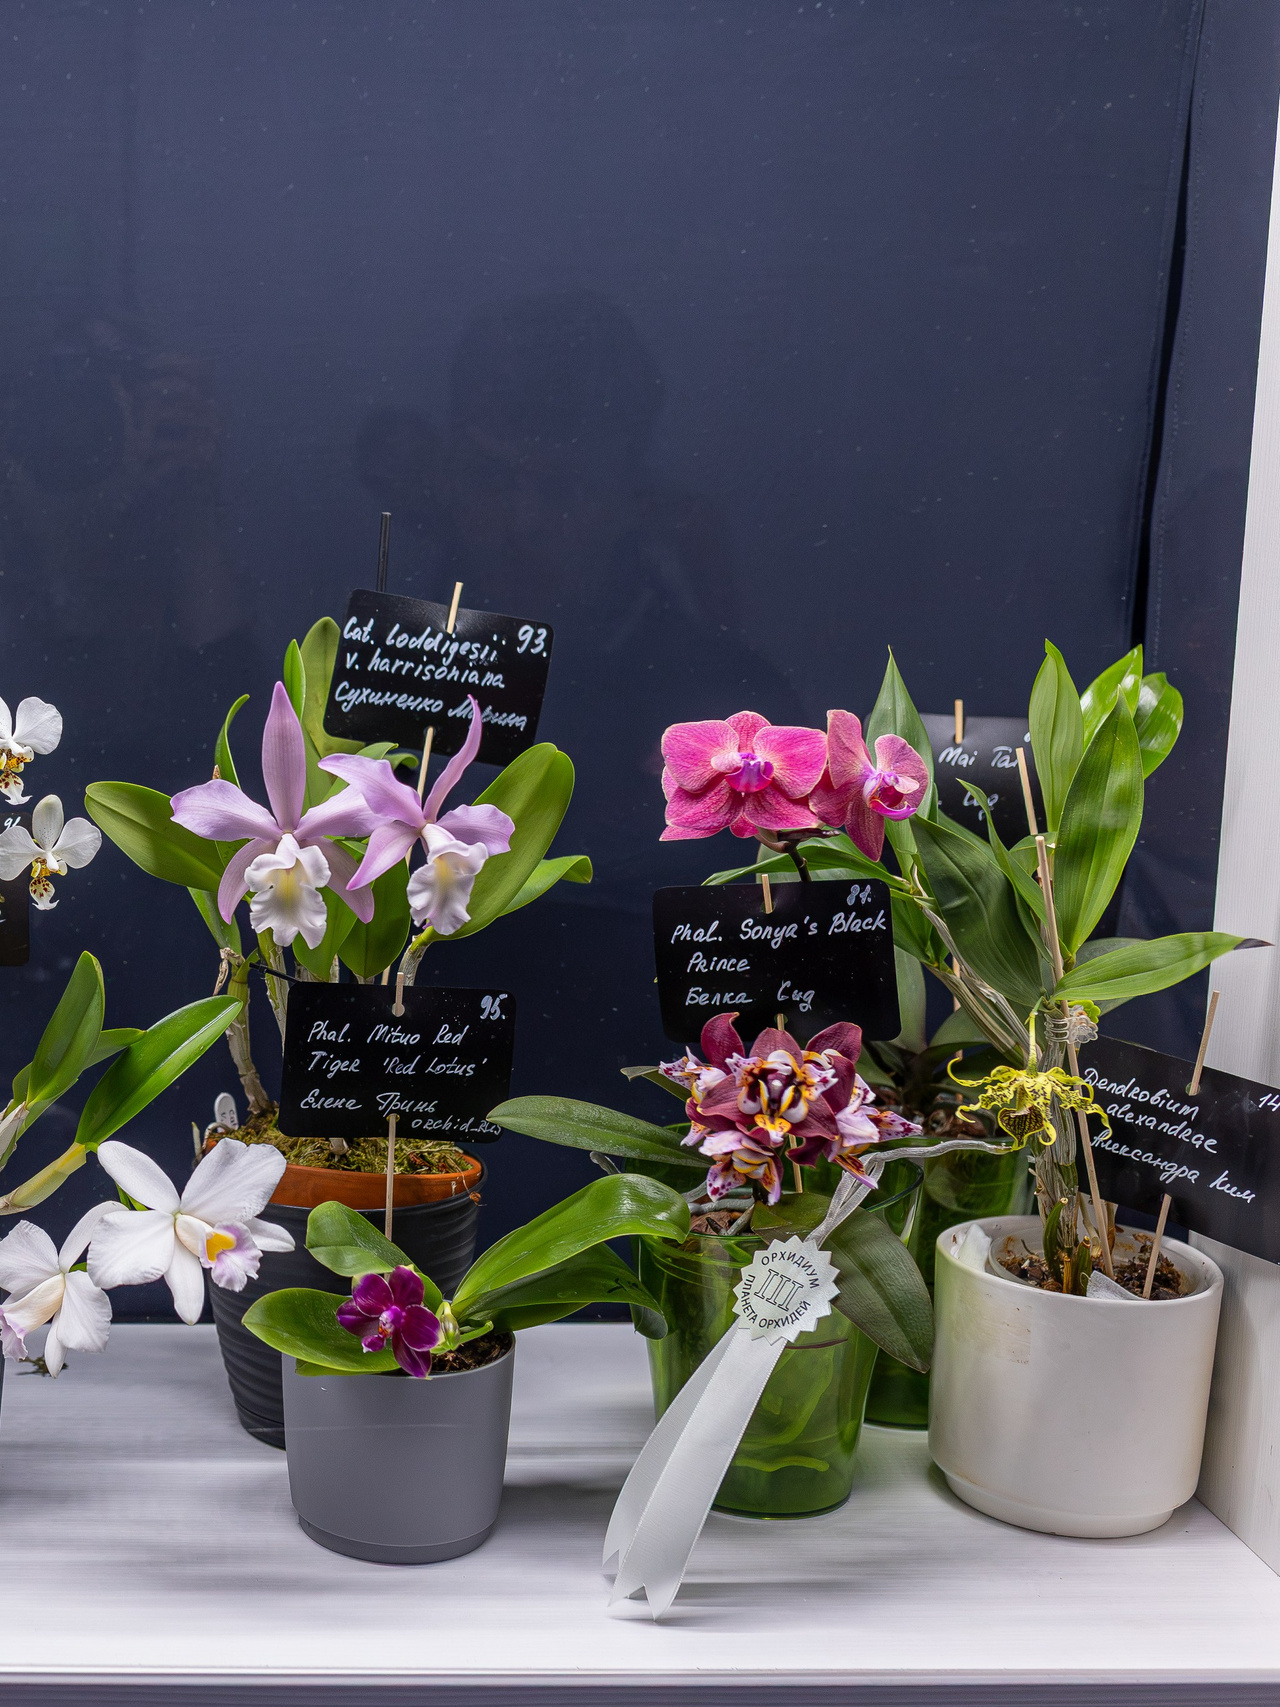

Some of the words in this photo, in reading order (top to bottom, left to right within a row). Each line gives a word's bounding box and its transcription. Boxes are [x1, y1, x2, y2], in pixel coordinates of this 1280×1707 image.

[516, 624, 548, 658] 93.
[367, 648, 505, 689] harrisoniana
[334, 680, 444, 713] Сухиненко
[938, 745, 978, 768] Mai
[671, 920, 723, 945] Phal.
[739, 915, 818, 949] Sonya's
[827, 910, 887, 935] Black
[479, 993, 508, 1020] 95.
[685, 986, 753, 1006] Белка
[307, 1020, 351, 1044] Phal.
[366, 1023, 421, 1044] Mituo
[432, 1023, 469, 1046] Red
[300, 1088, 363, 1110] Елена
[375, 1091, 440, 1118] Гринь
[1083, 1067, 1200, 1121] Dendrobium
[1090, 1128, 1200, 1184] Александра
[1208, 1170, 1256, 1204] Ким
[761, 1251, 820, 1289] ОРХИДИУМ
[741, 1274, 758, 1324] ПЛАНЕТА
[758, 1300, 812, 1329] ОРХИДЕЙ
